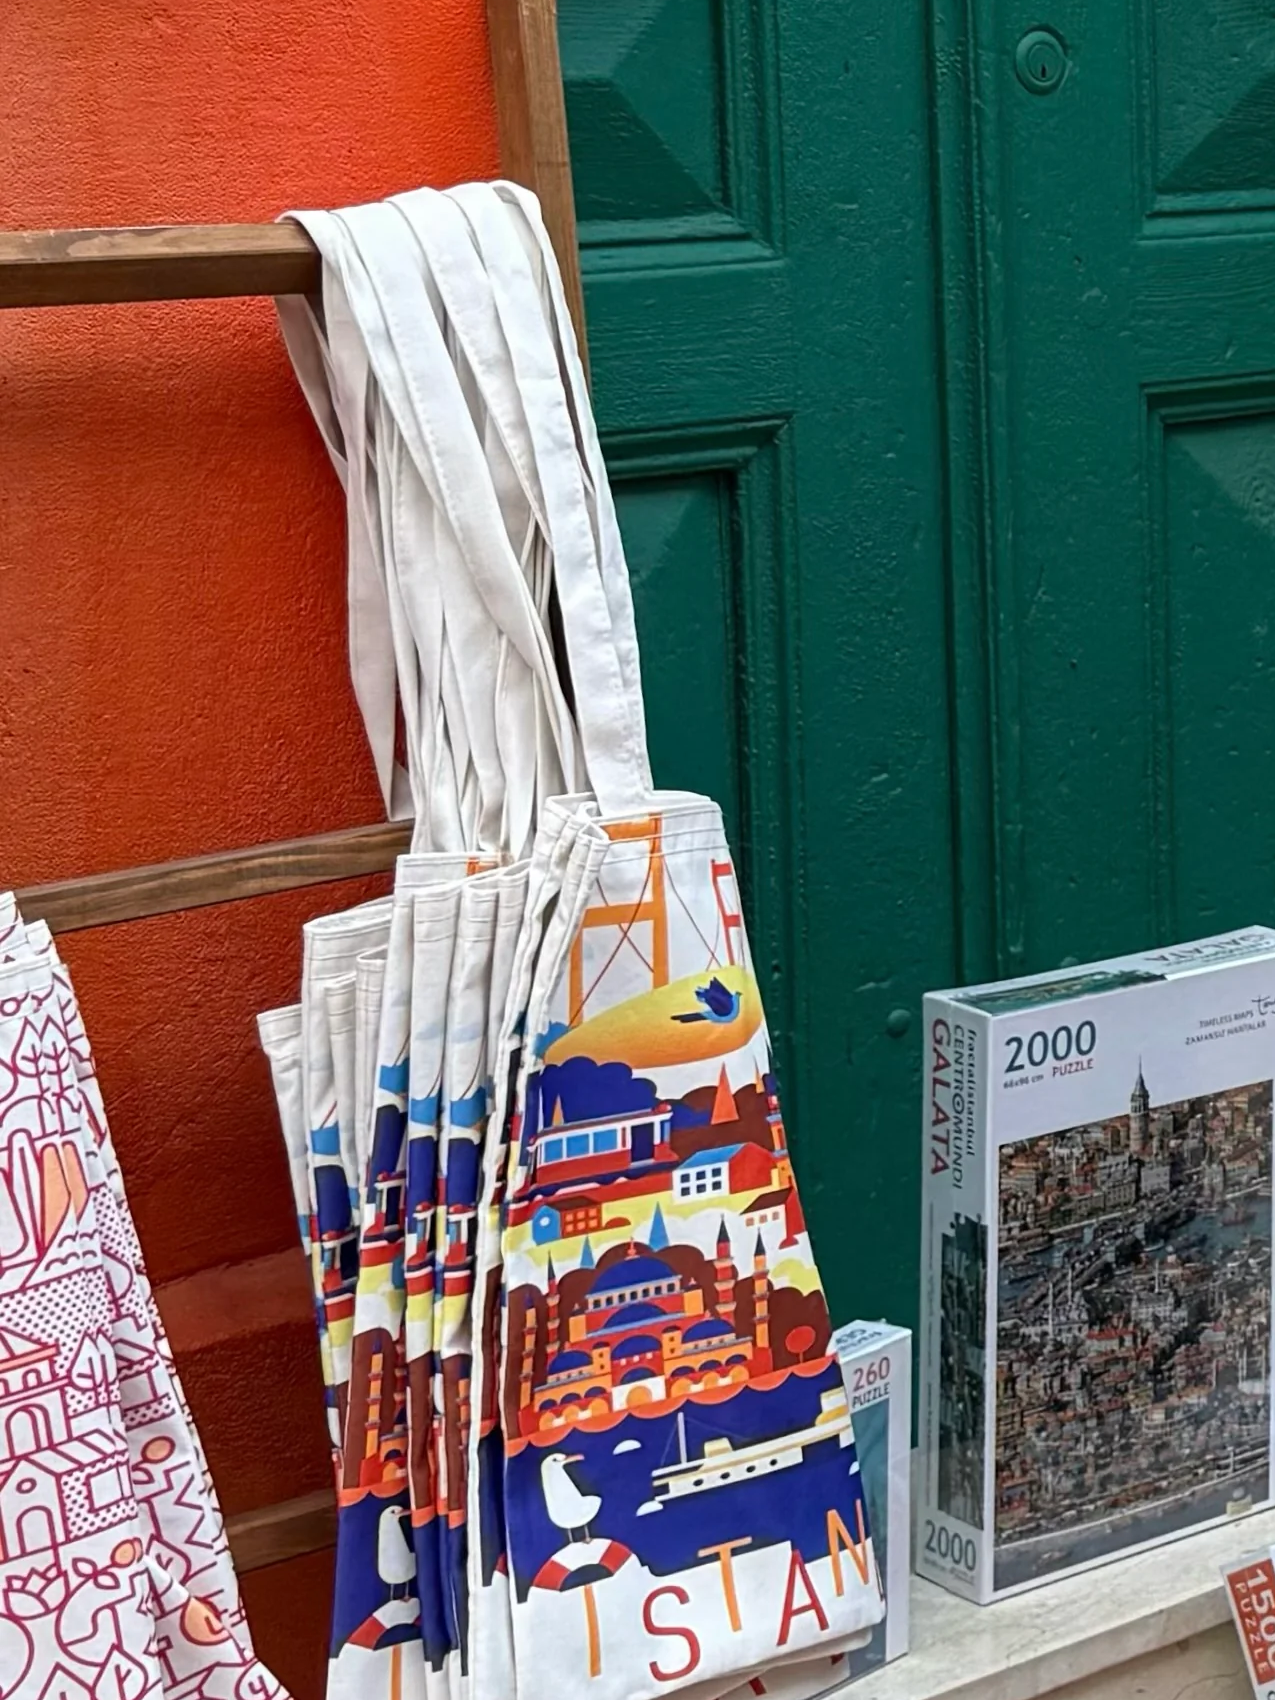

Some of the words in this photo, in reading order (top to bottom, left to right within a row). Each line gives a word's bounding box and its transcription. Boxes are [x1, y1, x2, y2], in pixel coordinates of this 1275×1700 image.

[1004, 1020, 1096, 1074] 2000
[1052, 1058, 1094, 1078] PUZZLE
[930, 1018, 952, 1176] GALATA
[952, 1024, 965, 1190] CENTROMUNDI
[852, 1382, 890, 1409] PUZZLE
[853, 1356, 890, 1393] 260
[925, 1519, 976, 1571] 2000
[1235, 1583, 1267, 1675] PUZZLE
